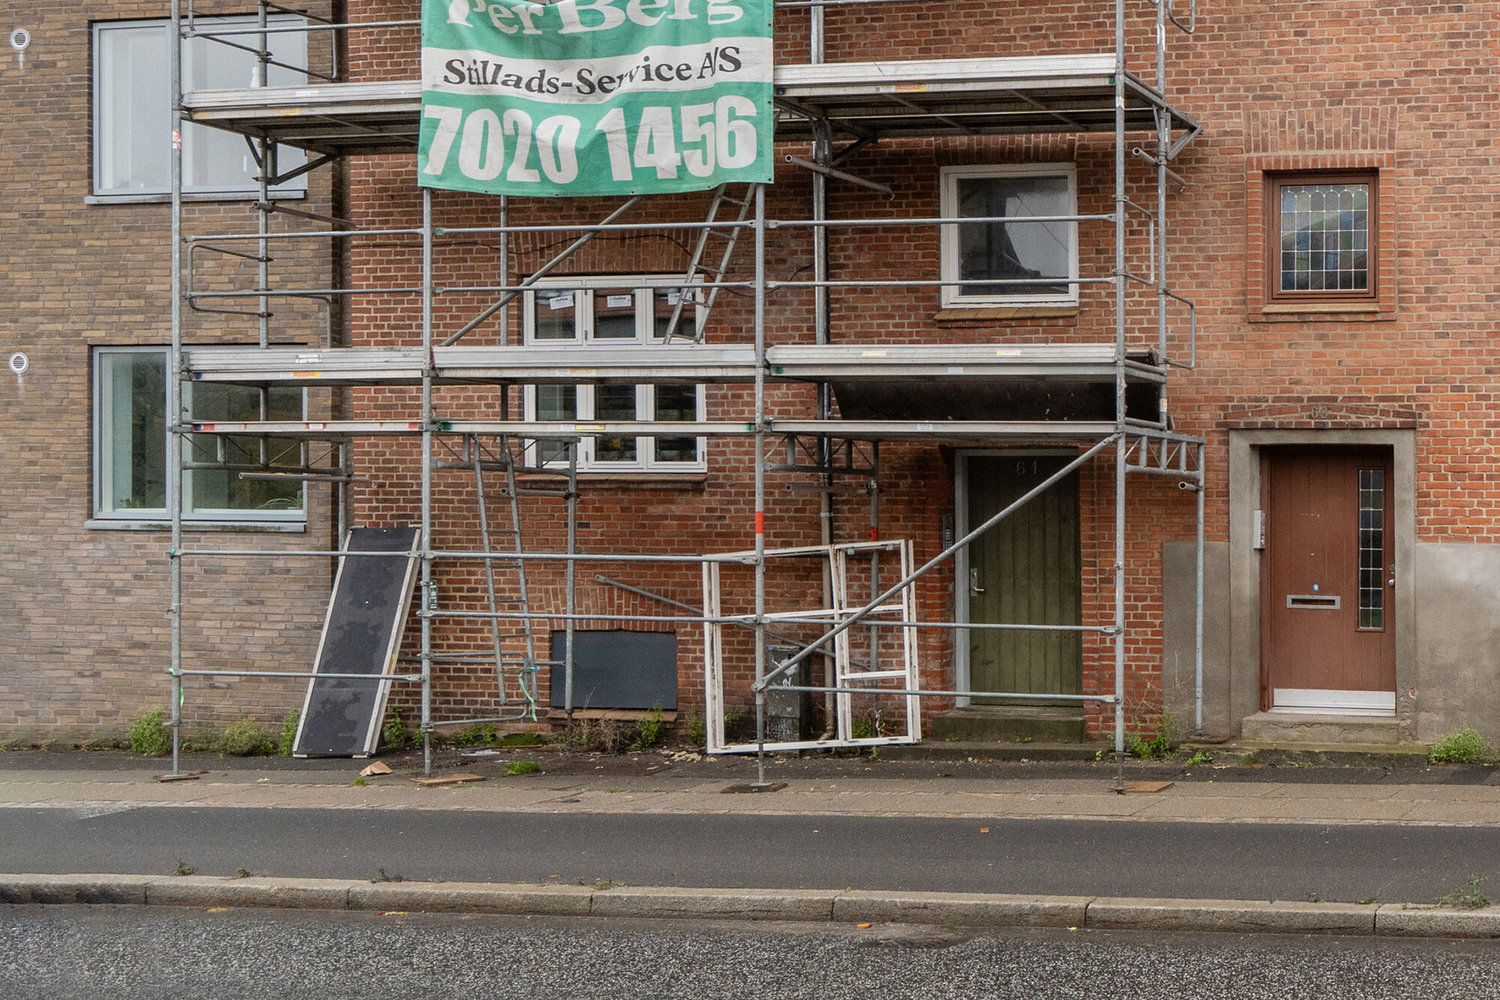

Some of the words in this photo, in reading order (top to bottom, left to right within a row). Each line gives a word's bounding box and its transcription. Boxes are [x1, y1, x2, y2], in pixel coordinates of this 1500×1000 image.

[442, 55, 693, 95] Stillads-Service
[695, 46, 743, 80] A/S
[423, 104, 581, 184] 7020
[594, 95, 758, 182] 1456
[1015, 460, 1037, 475] 61
